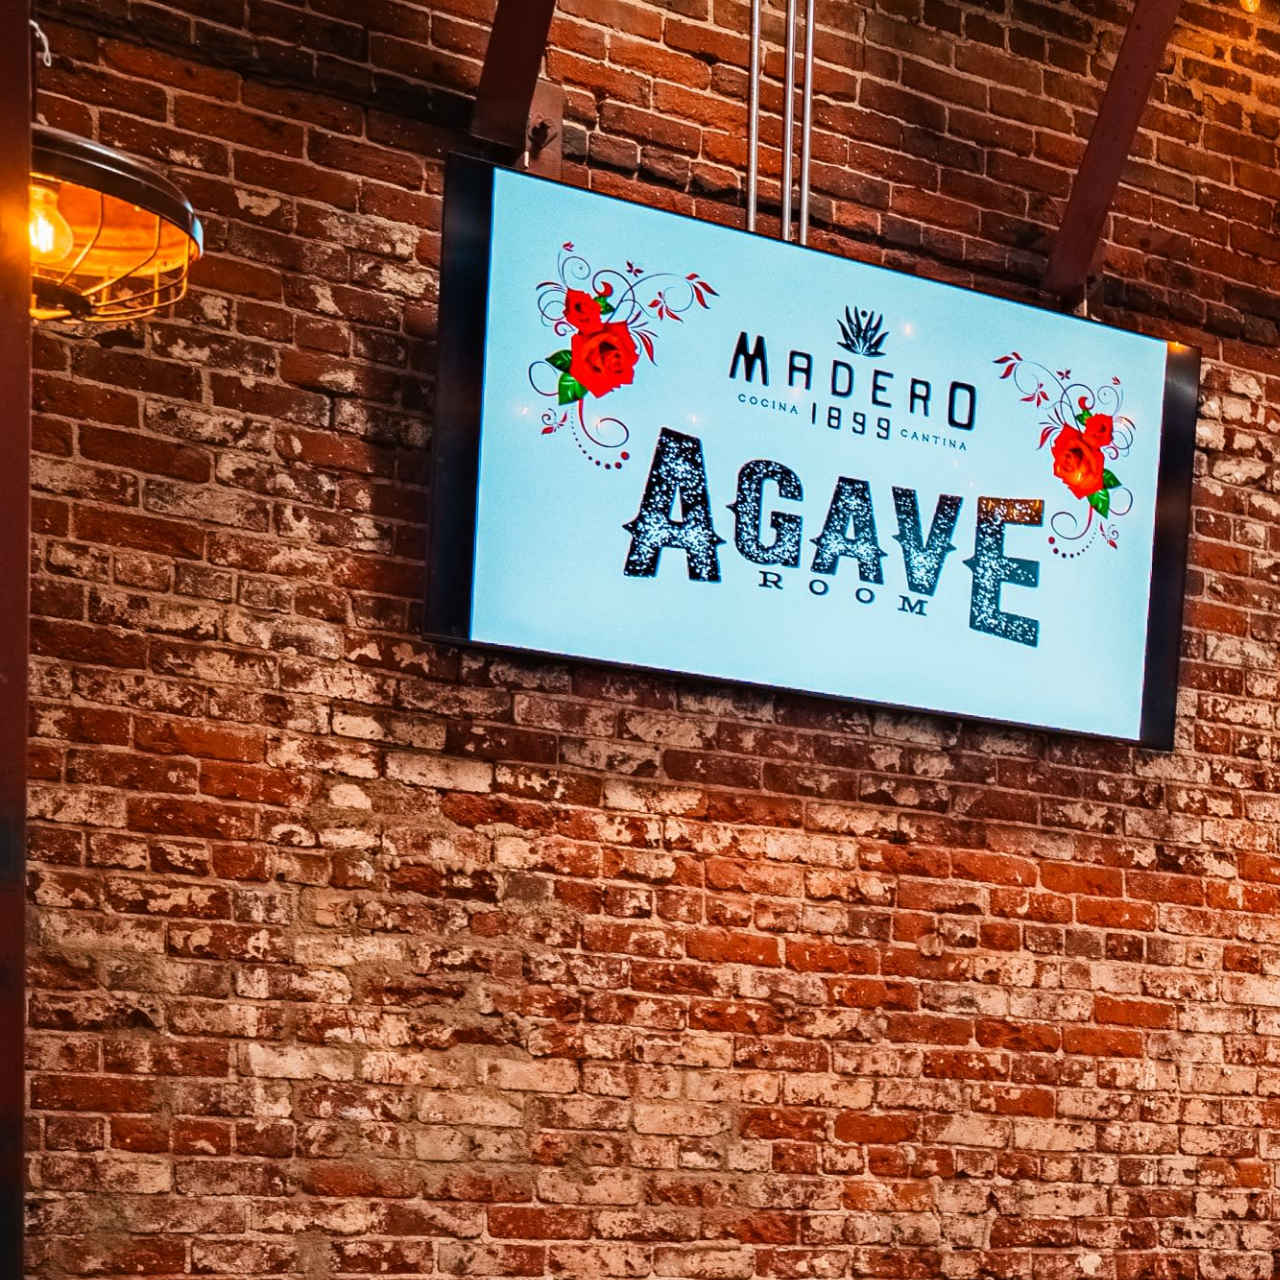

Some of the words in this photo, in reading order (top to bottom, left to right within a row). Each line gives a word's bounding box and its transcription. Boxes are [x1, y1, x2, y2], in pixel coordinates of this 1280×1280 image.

[729, 331, 977, 432] MADERO
[738, 393, 799, 416] COCINA
[811, 401, 891, 441] 1899
[900, 428, 968, 451] CANTINA
[622, 427, 1046, 648] AGAVE
[757, 570, 928, 617] ROOM
